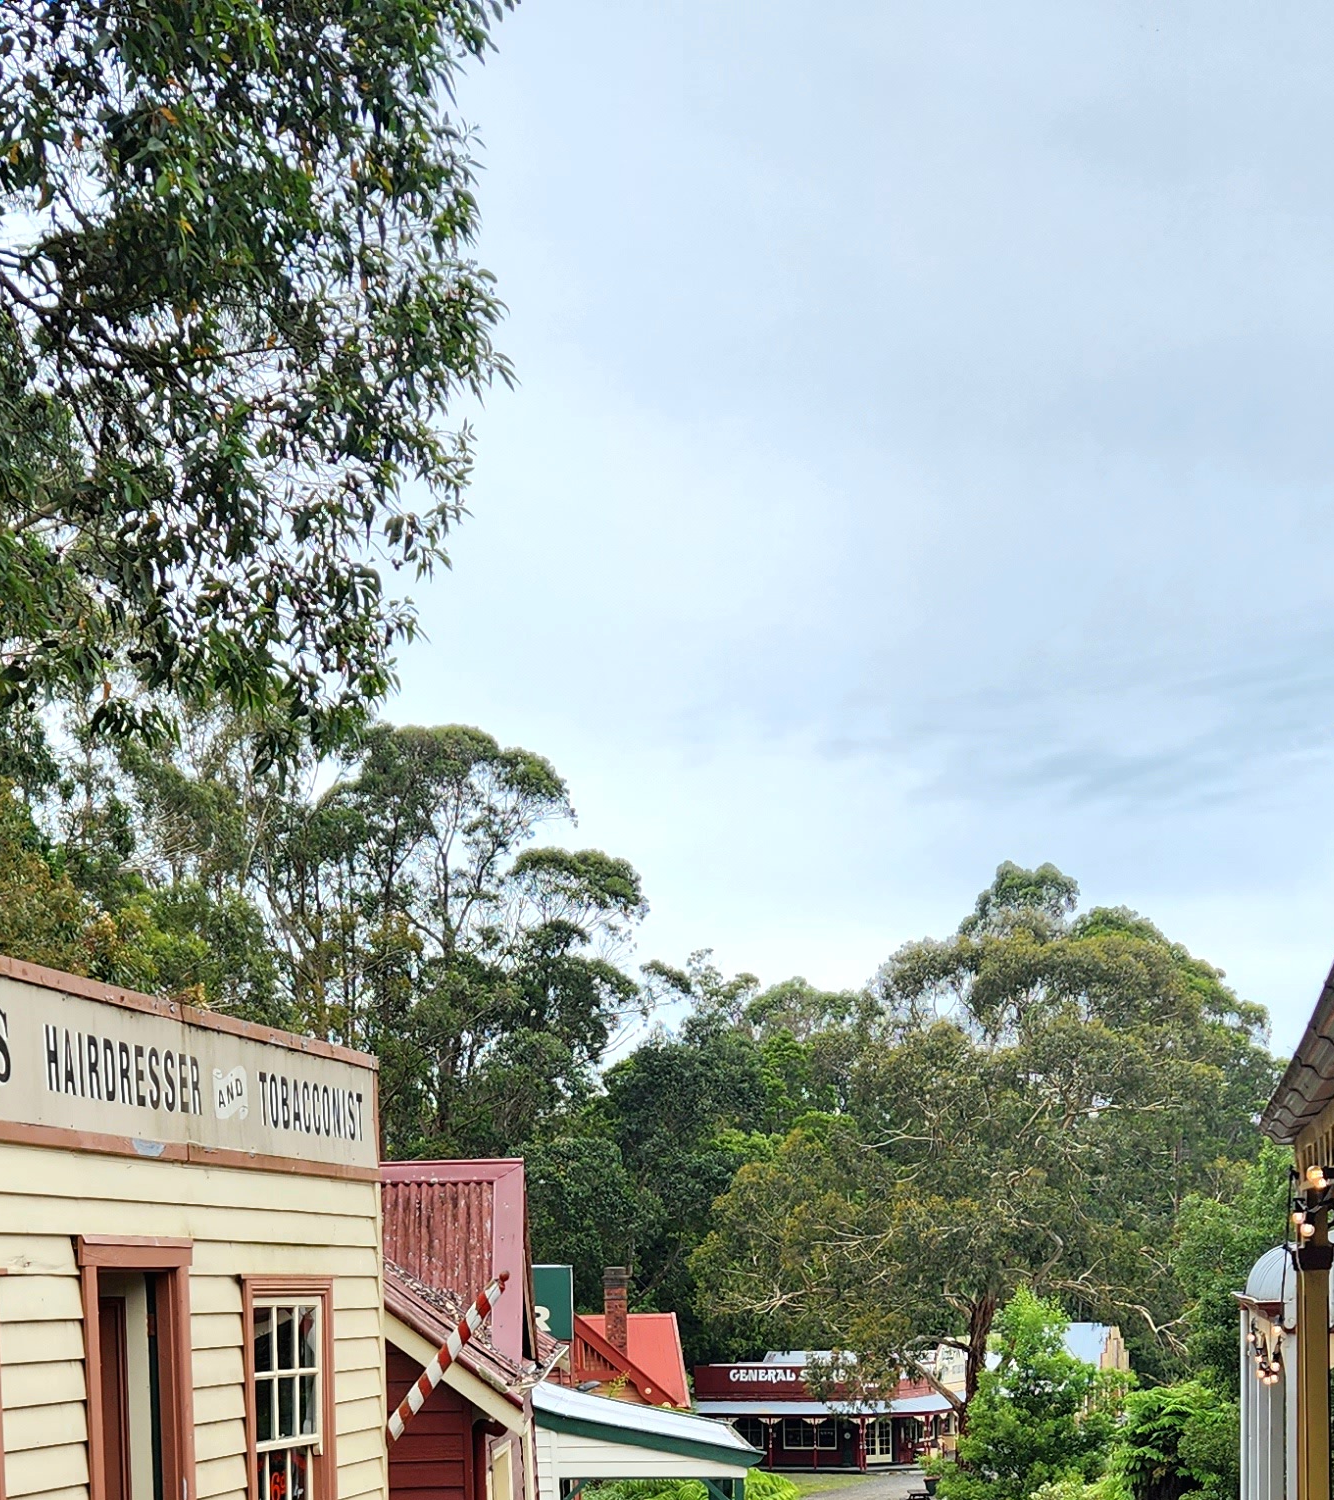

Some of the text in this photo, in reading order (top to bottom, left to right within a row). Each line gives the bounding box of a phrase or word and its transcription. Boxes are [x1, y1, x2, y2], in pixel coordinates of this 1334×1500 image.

[43, 1024, 203, 1116] HAIRDRESSER
[218, 1077, 244, 1109] AND
[257, 1071, 364, 1142] TOBACCONIST
[729, 1369, 796, 1384] GENERAL
